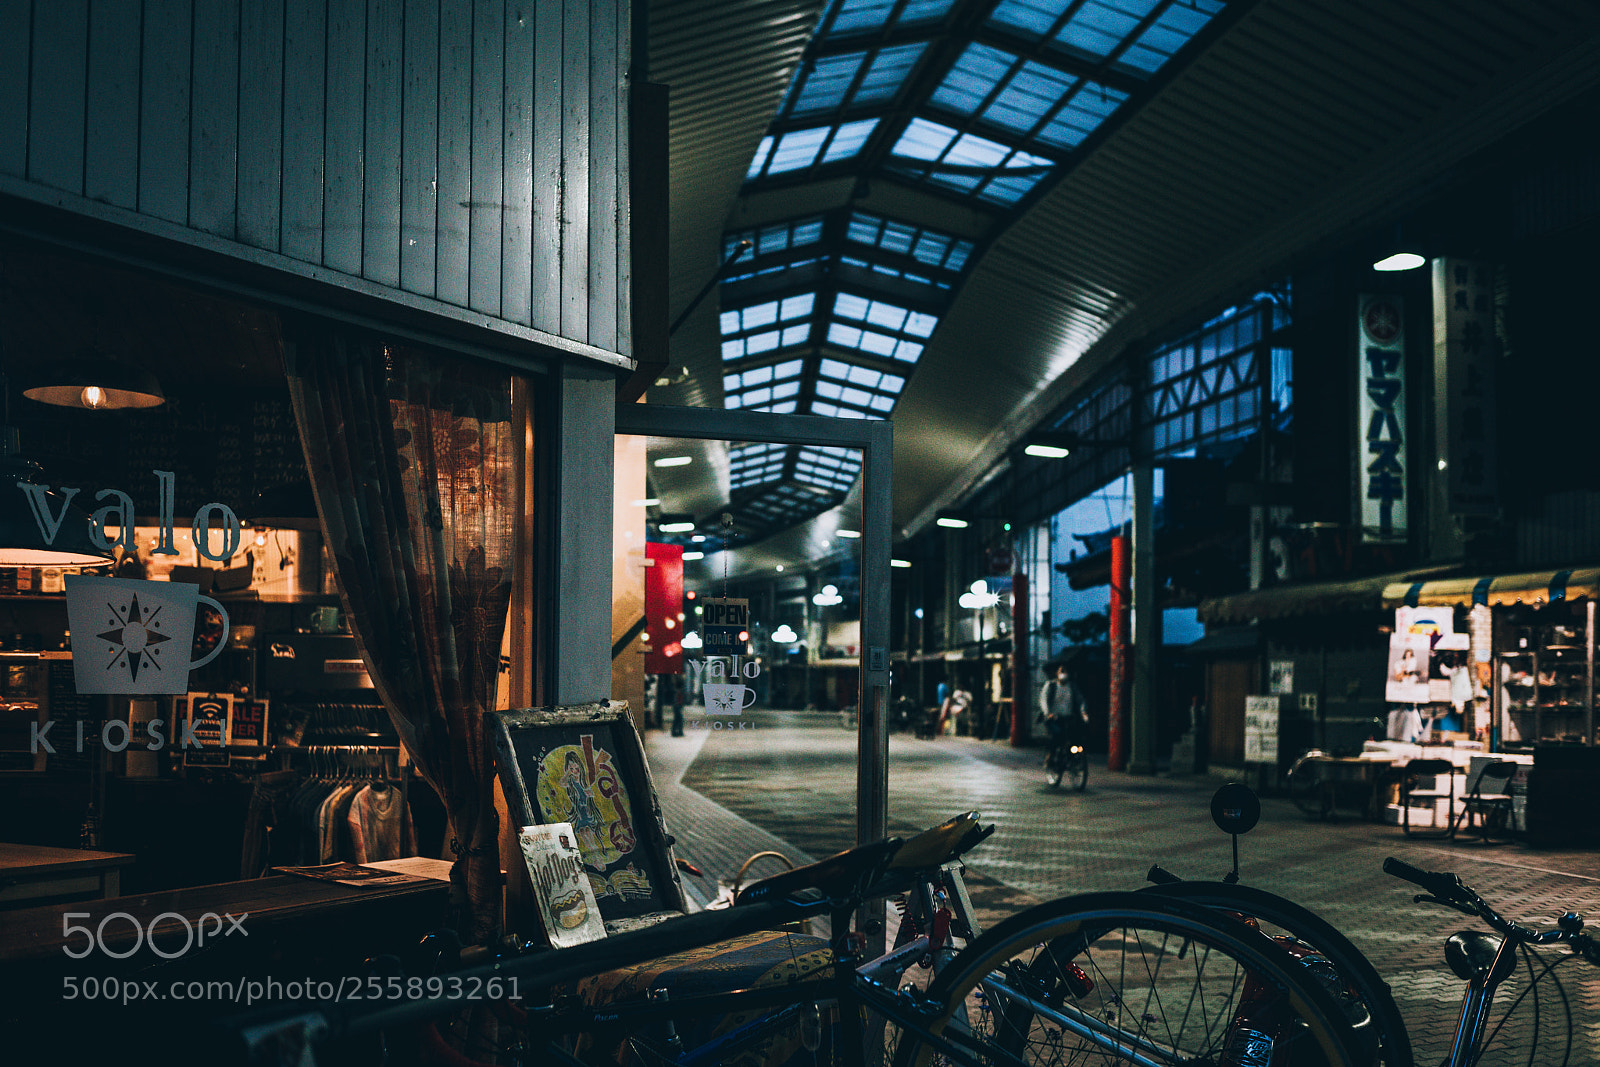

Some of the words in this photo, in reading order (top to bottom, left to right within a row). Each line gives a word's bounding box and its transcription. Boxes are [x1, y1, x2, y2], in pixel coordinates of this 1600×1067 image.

[17, 469, 241, 561] valo
[703, 604, 747, 625] OPEN
[705, 633, 732, 646] COME
[688, 654, 761, 678] valo
[233, 705, 261, 722] ALE
[31, 718, 227, 754] KIOSKI
[691, 720, 756, 731] KIOSKI
